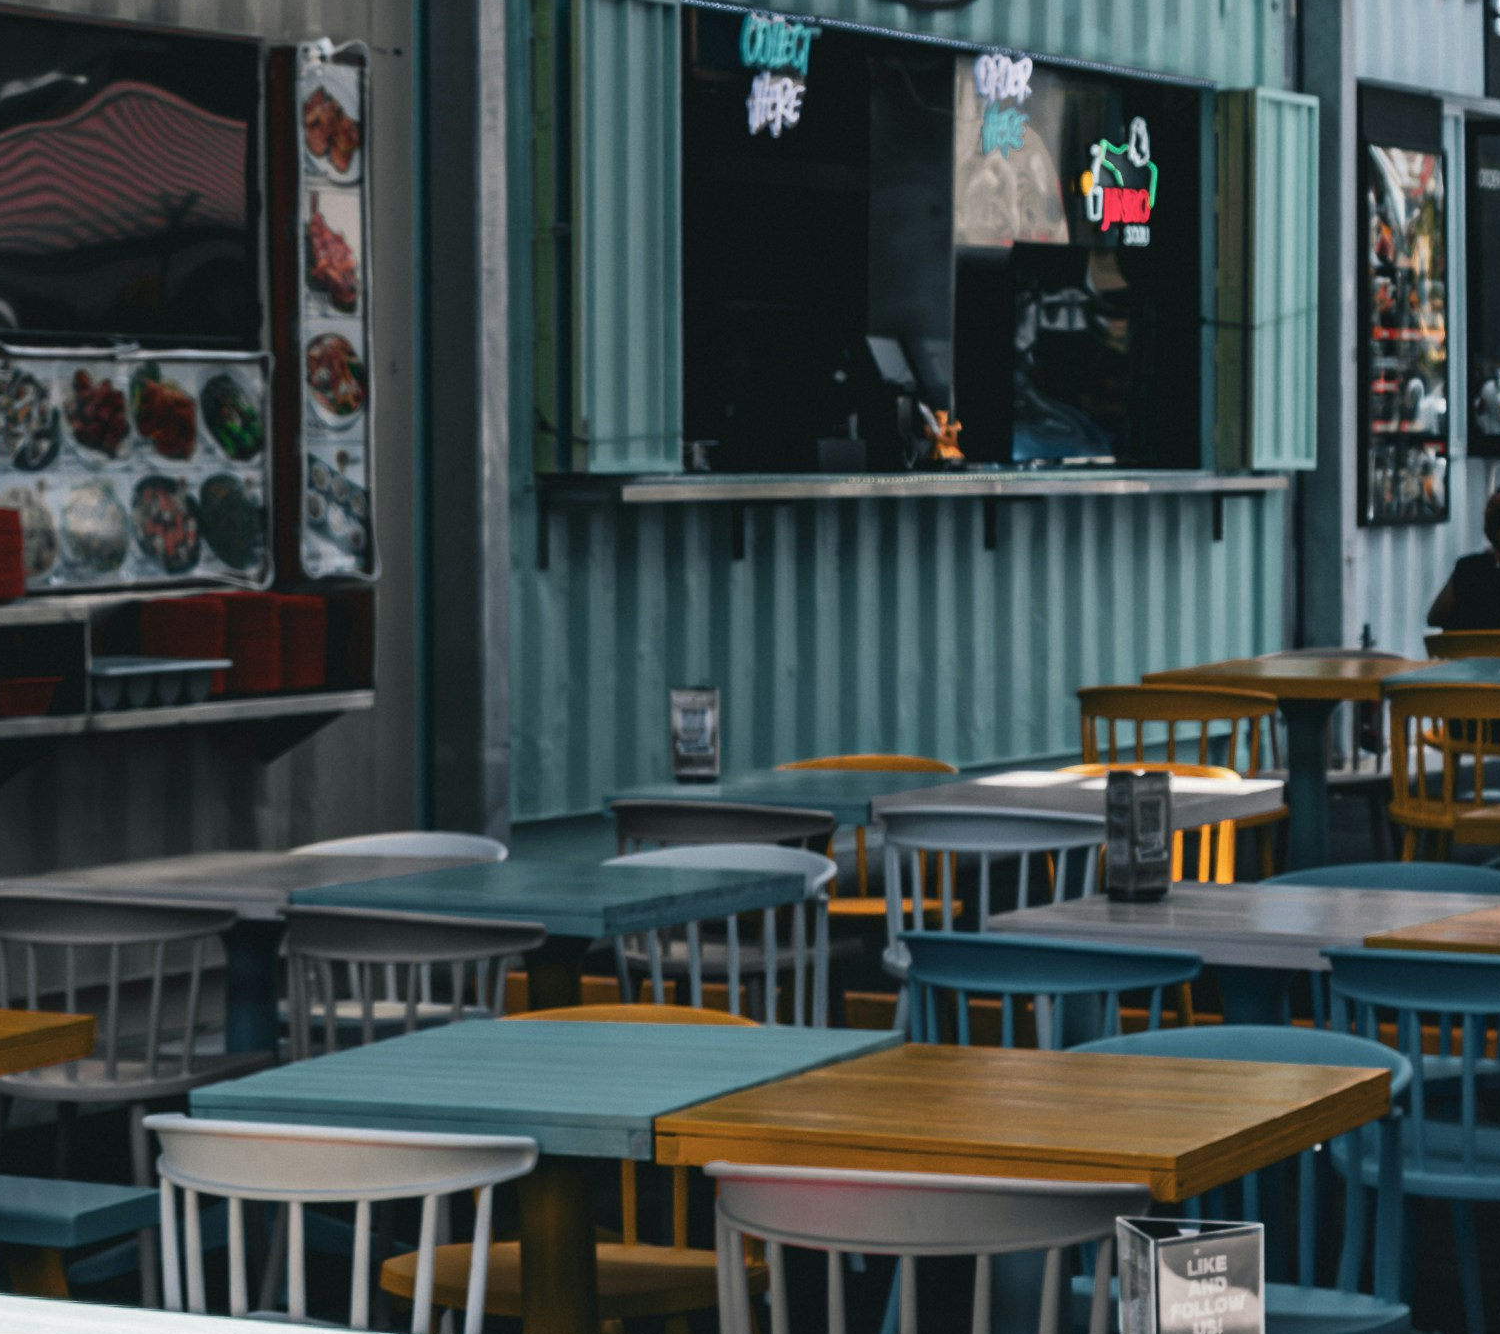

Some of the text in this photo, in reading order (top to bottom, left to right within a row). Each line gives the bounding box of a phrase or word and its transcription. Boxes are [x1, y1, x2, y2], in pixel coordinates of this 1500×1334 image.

[740, 12, 820, 76] COLLECT
[746, 71, 806, 139] HERE
[974, 54, 1033, 105] ORDER
[982, 99, 1029, 160] HERE
[1187, 1255, 1227, 1277] LIKE
[1188, 1275, 1228, 1298] AND
[1169, 1292, 1248, 1323] FOLLOW
